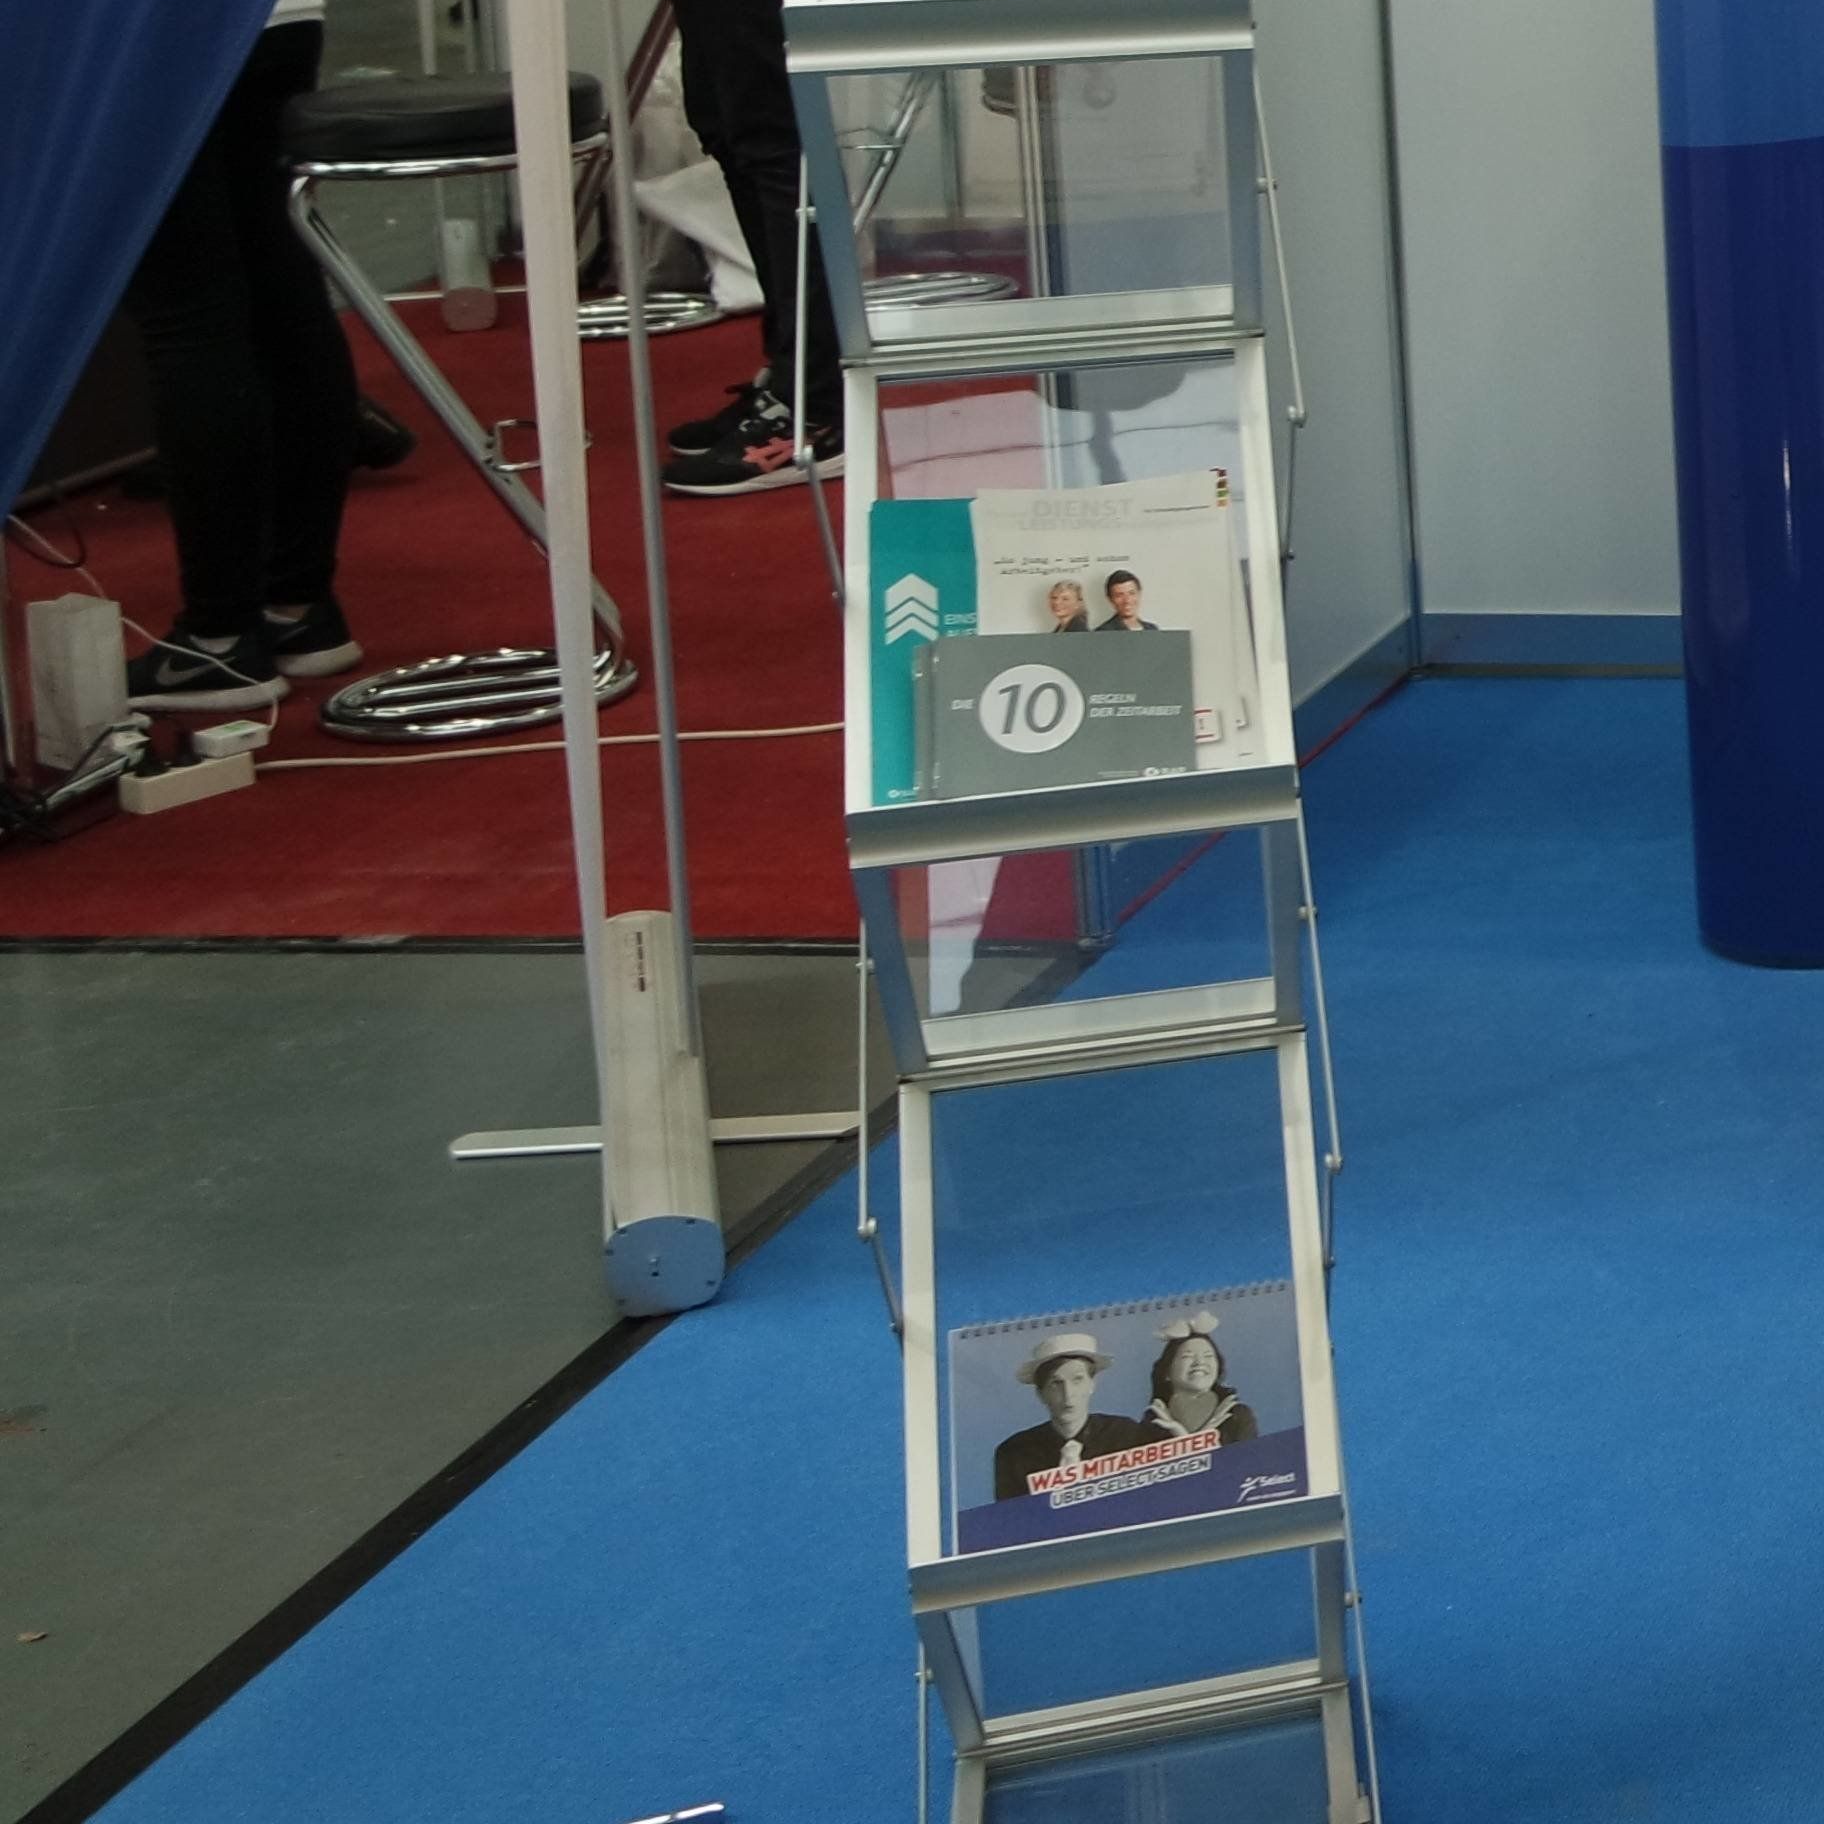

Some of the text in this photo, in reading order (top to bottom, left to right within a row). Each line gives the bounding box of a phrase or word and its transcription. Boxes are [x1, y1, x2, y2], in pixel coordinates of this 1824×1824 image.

[951, 681, 1067, 735] DIE 10
[1031, 1431, 1218, 1492] WAS MITARBEITER
[1098, 1473, 1156, 1496] SELECT
[1158, 1457, 1210, 1481] SAGEN
